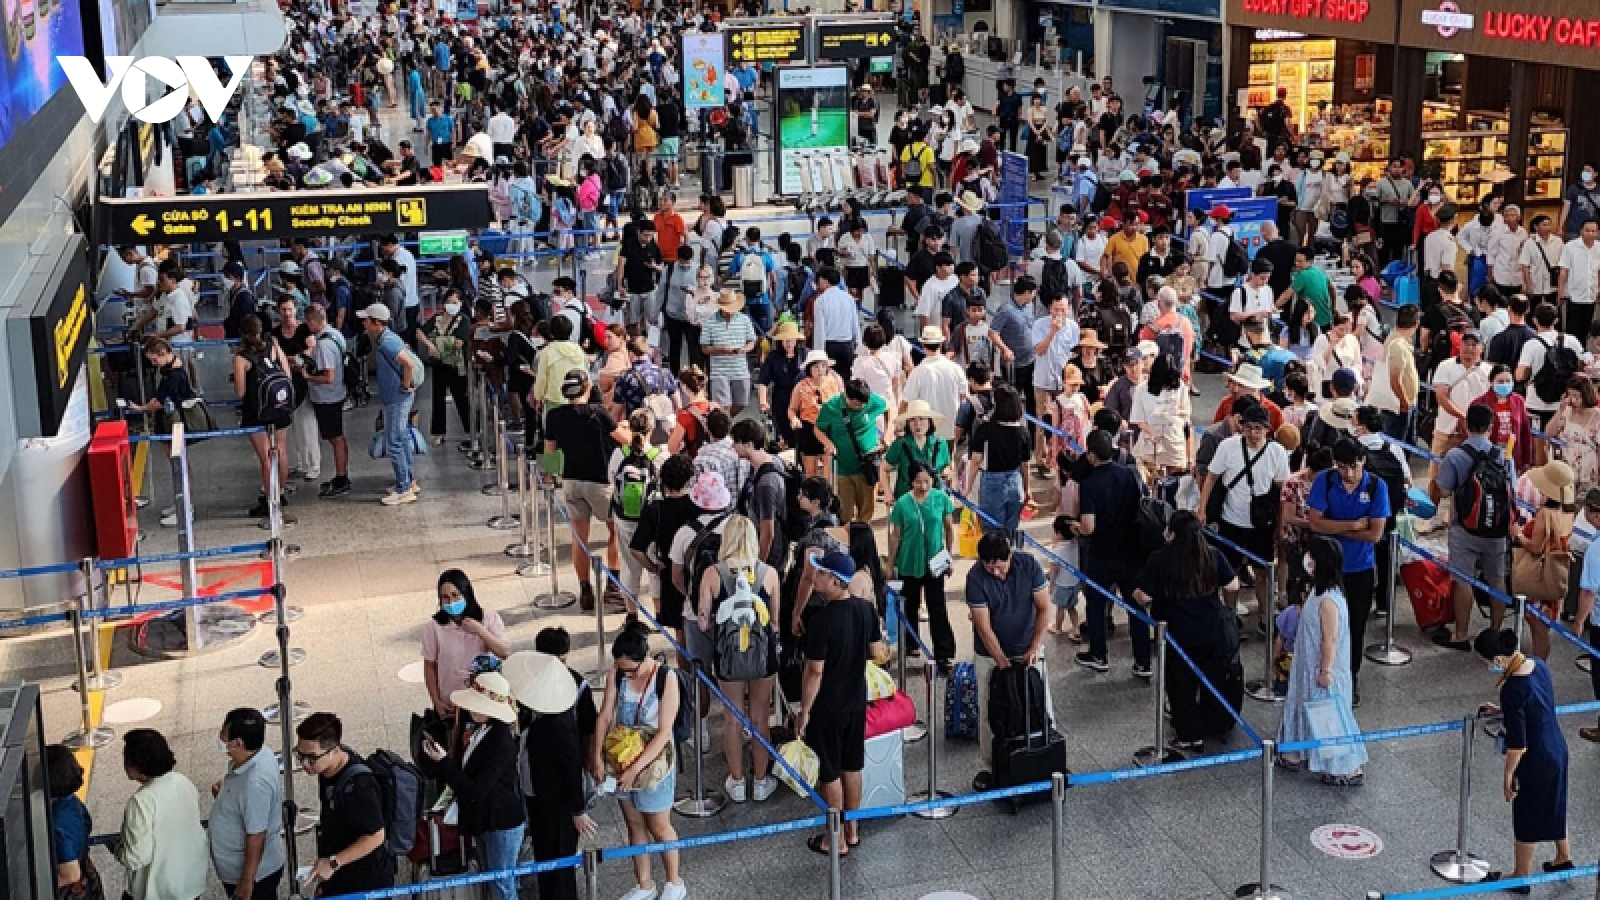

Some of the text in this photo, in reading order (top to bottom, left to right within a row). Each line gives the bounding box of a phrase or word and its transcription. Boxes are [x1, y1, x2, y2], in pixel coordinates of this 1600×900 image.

[1243, 0, 1369, 22] LUCKY GIFT SHOP
[1483, 10, 1600, 50] LUCKY CAF
[321, 203, 346, 214] TRA
[346, 202, 363, 213] AN
[363, 201, 392, 213] NINH
[163, 223, 197, 235] Gates
[291, 215, 372, 229] Security Check
